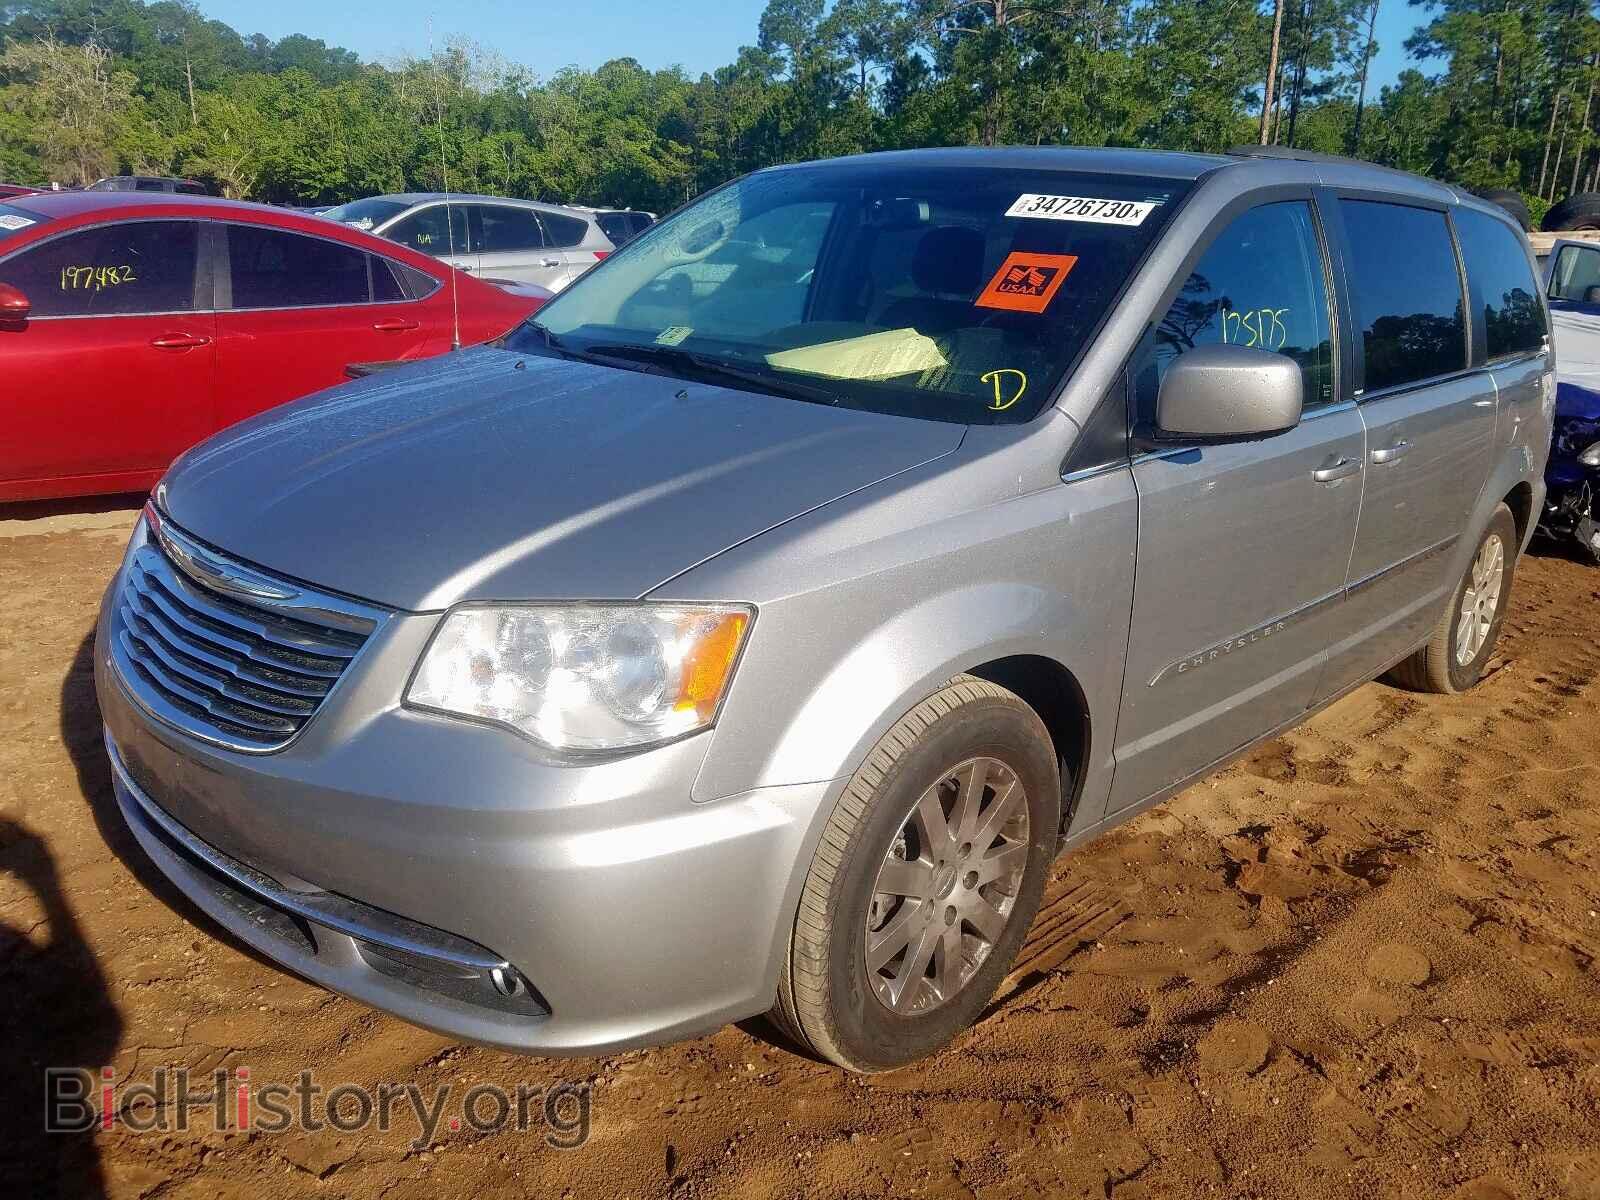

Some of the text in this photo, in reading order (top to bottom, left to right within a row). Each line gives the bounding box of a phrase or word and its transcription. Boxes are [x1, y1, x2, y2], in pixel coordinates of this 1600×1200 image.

[61, 265, 137, 291] 197,482
[999, 282, 1038, 294] USAA
[980, 369, 1027, 410] D
[1178, 621, 1284, 673] CHRYSLER
